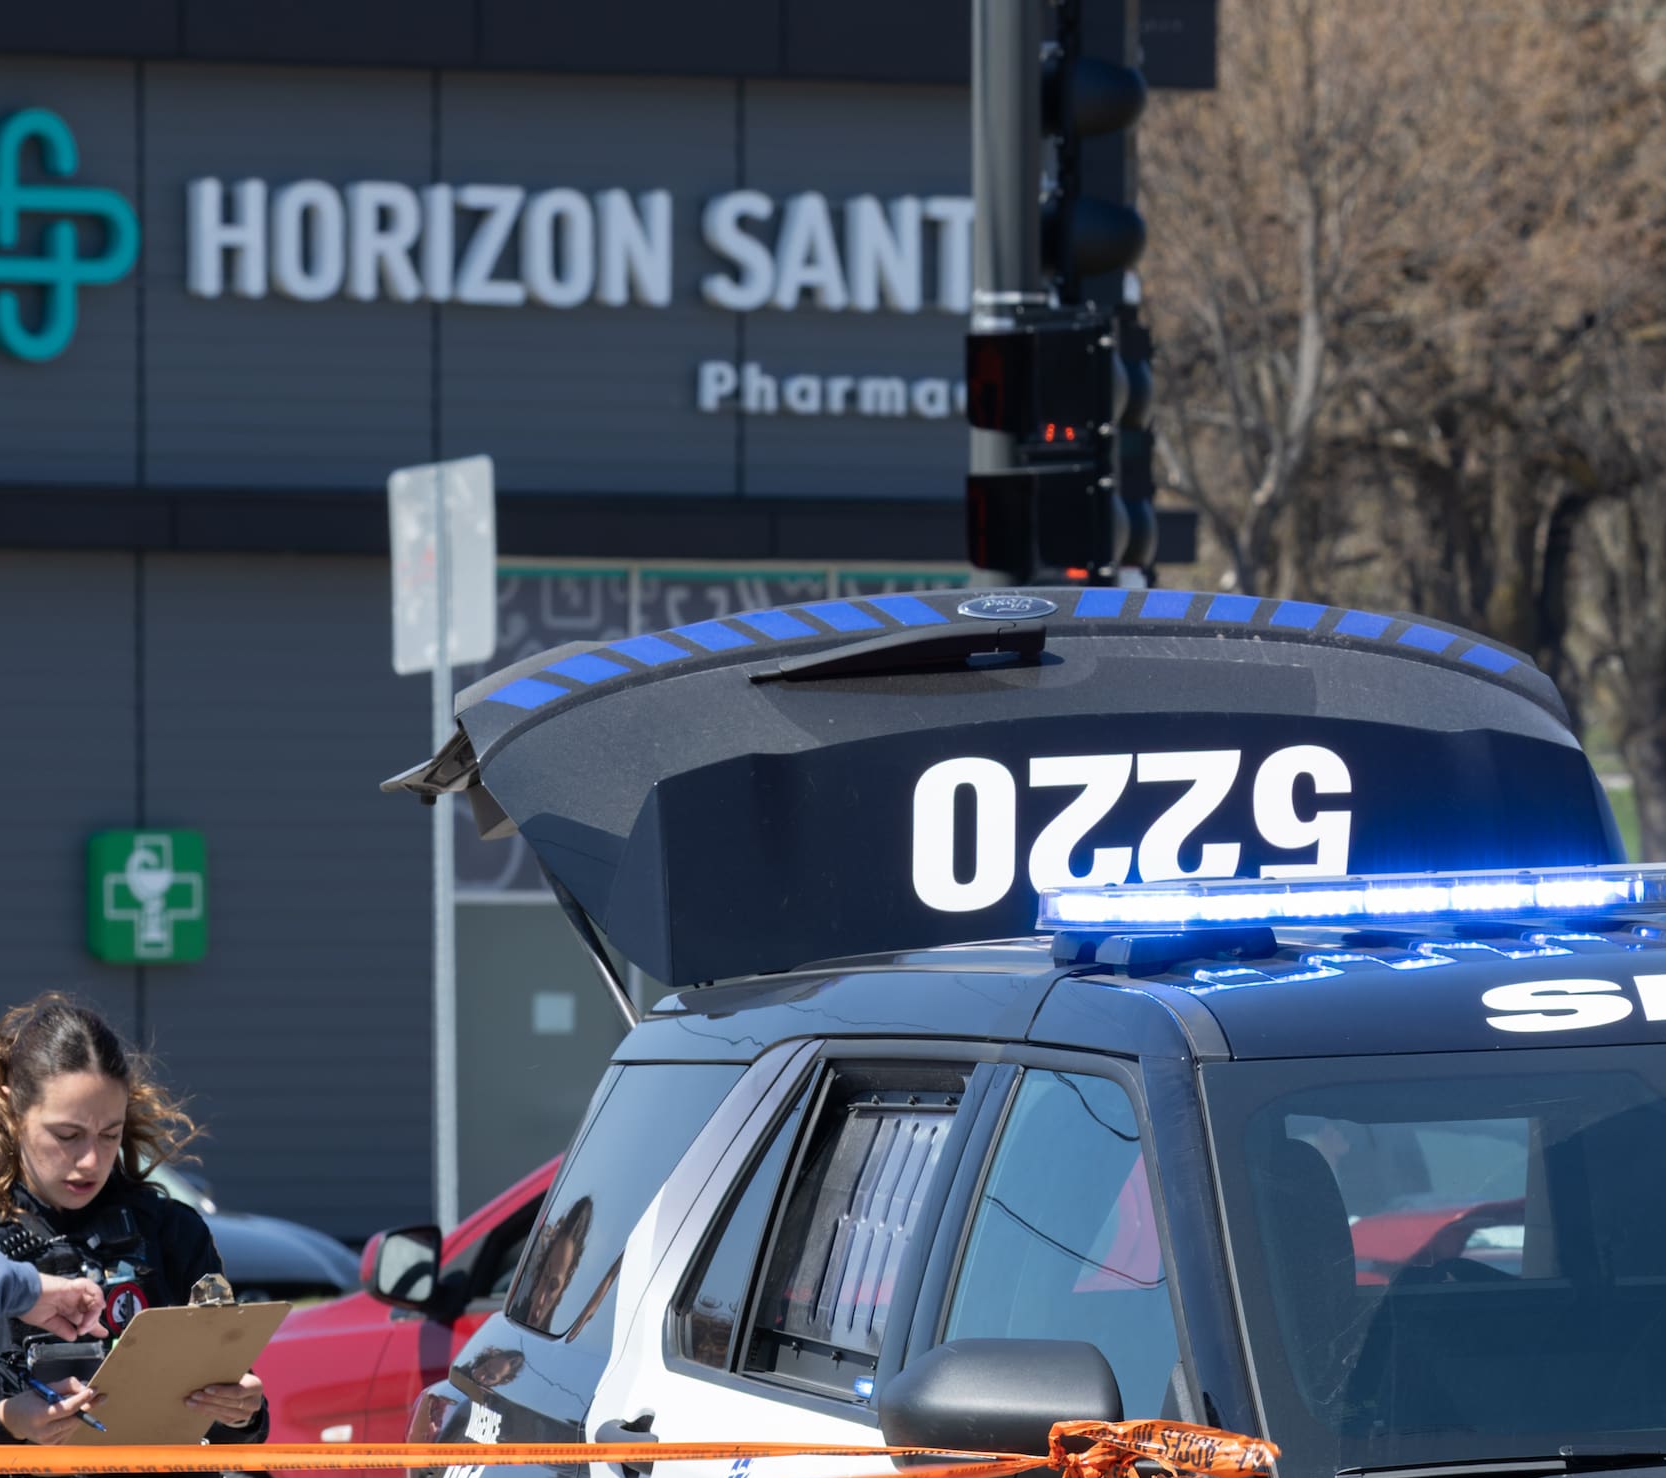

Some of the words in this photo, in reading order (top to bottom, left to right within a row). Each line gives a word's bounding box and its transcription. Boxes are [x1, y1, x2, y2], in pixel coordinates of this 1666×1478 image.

[186, 176, 674, 308] HORIZON
[700, 188, 979, 314] SANT
[697, 358, 969, 419] Pharma
[912, 744, 1353, 913] 5220
